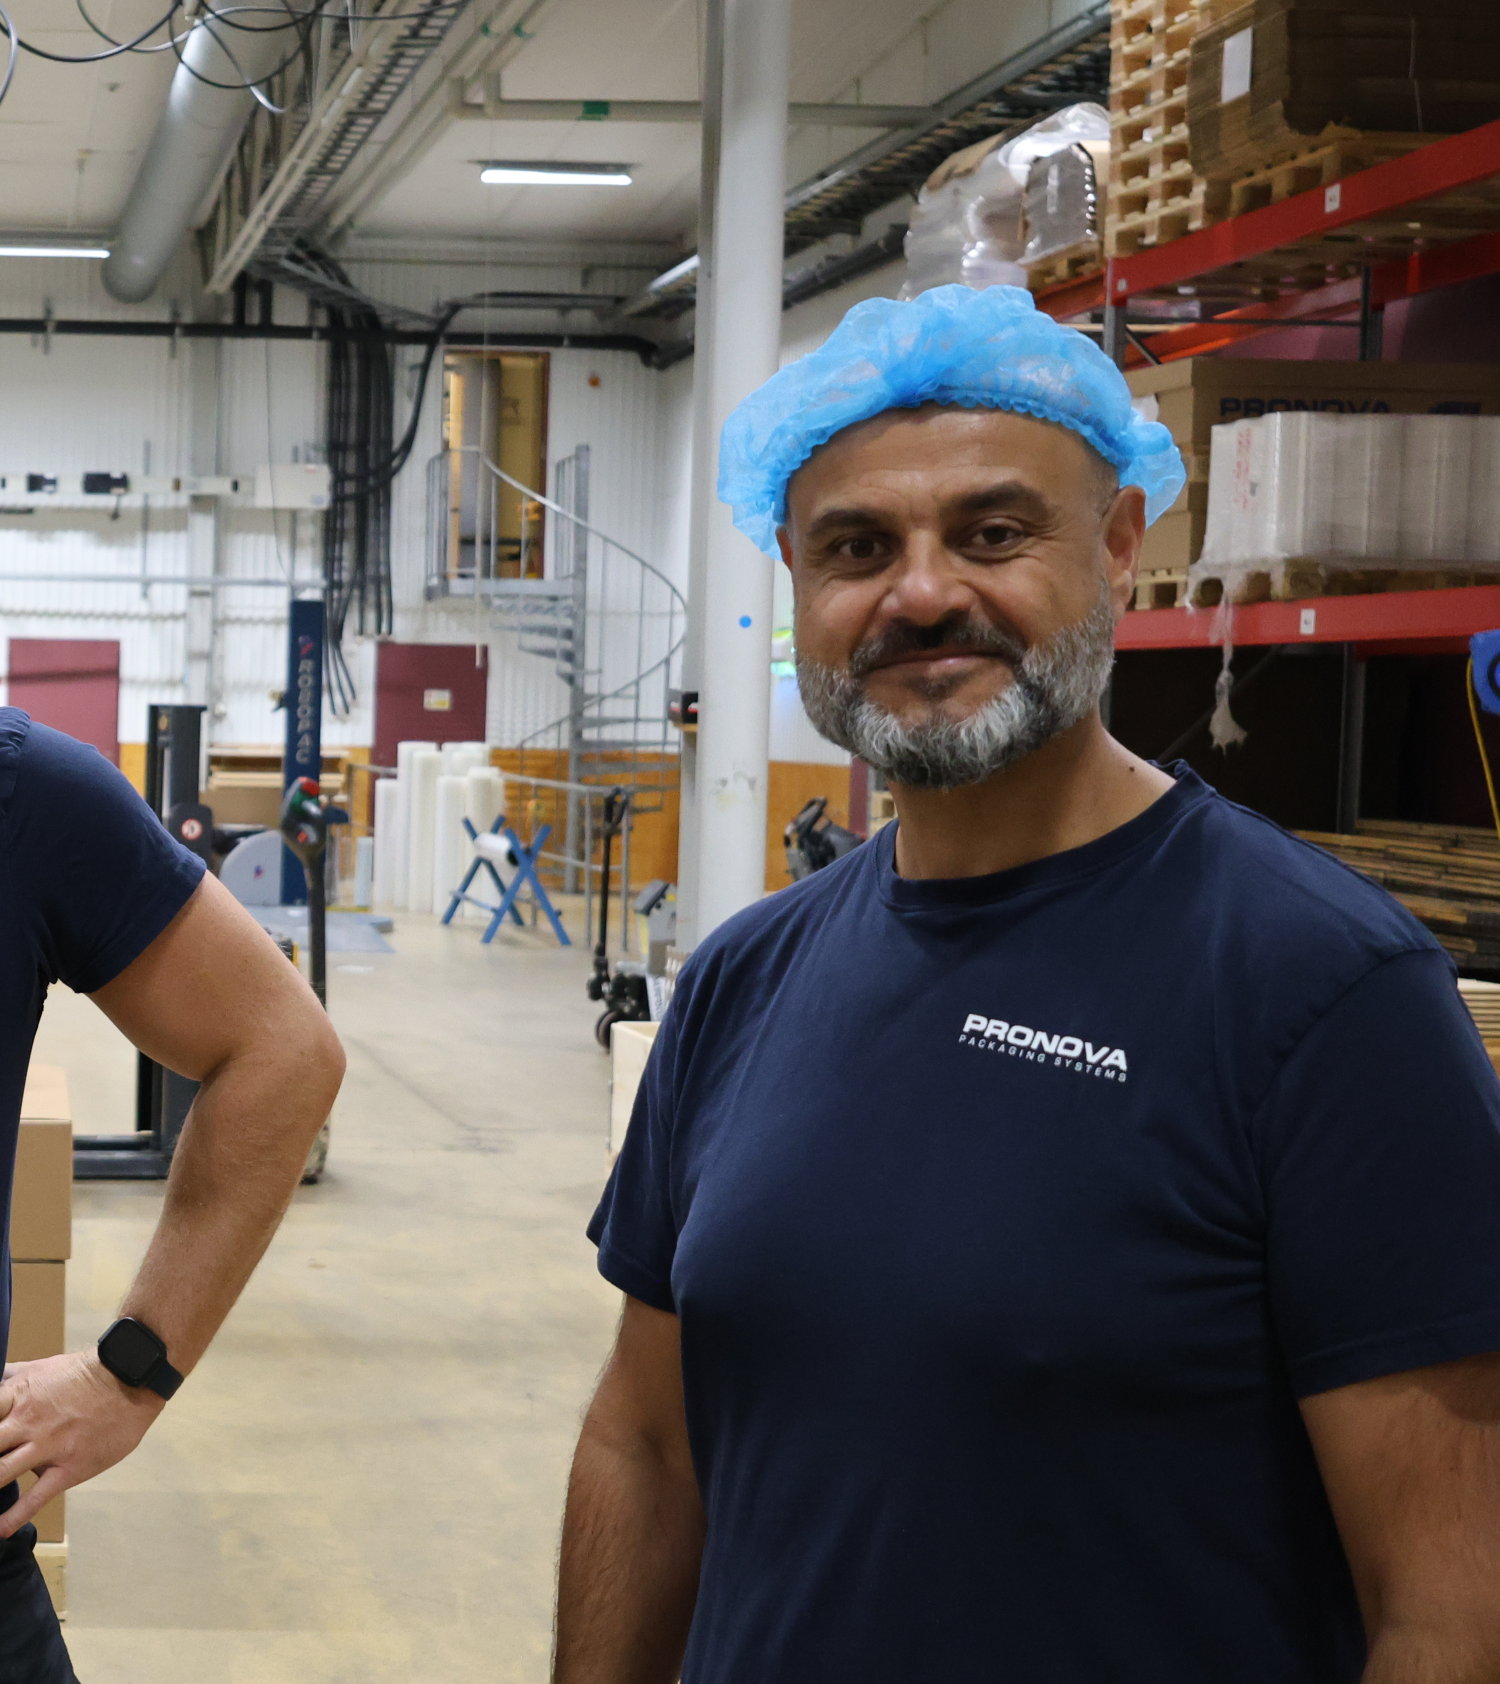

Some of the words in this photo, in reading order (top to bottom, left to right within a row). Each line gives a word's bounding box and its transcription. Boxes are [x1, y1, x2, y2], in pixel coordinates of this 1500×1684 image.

[958, 1034, 1046, 1063] PACKAGING
[1053, 1056, 1127, 1083] SYSTEMS
[962, 1013, 1128, 1072] PRONOVA
